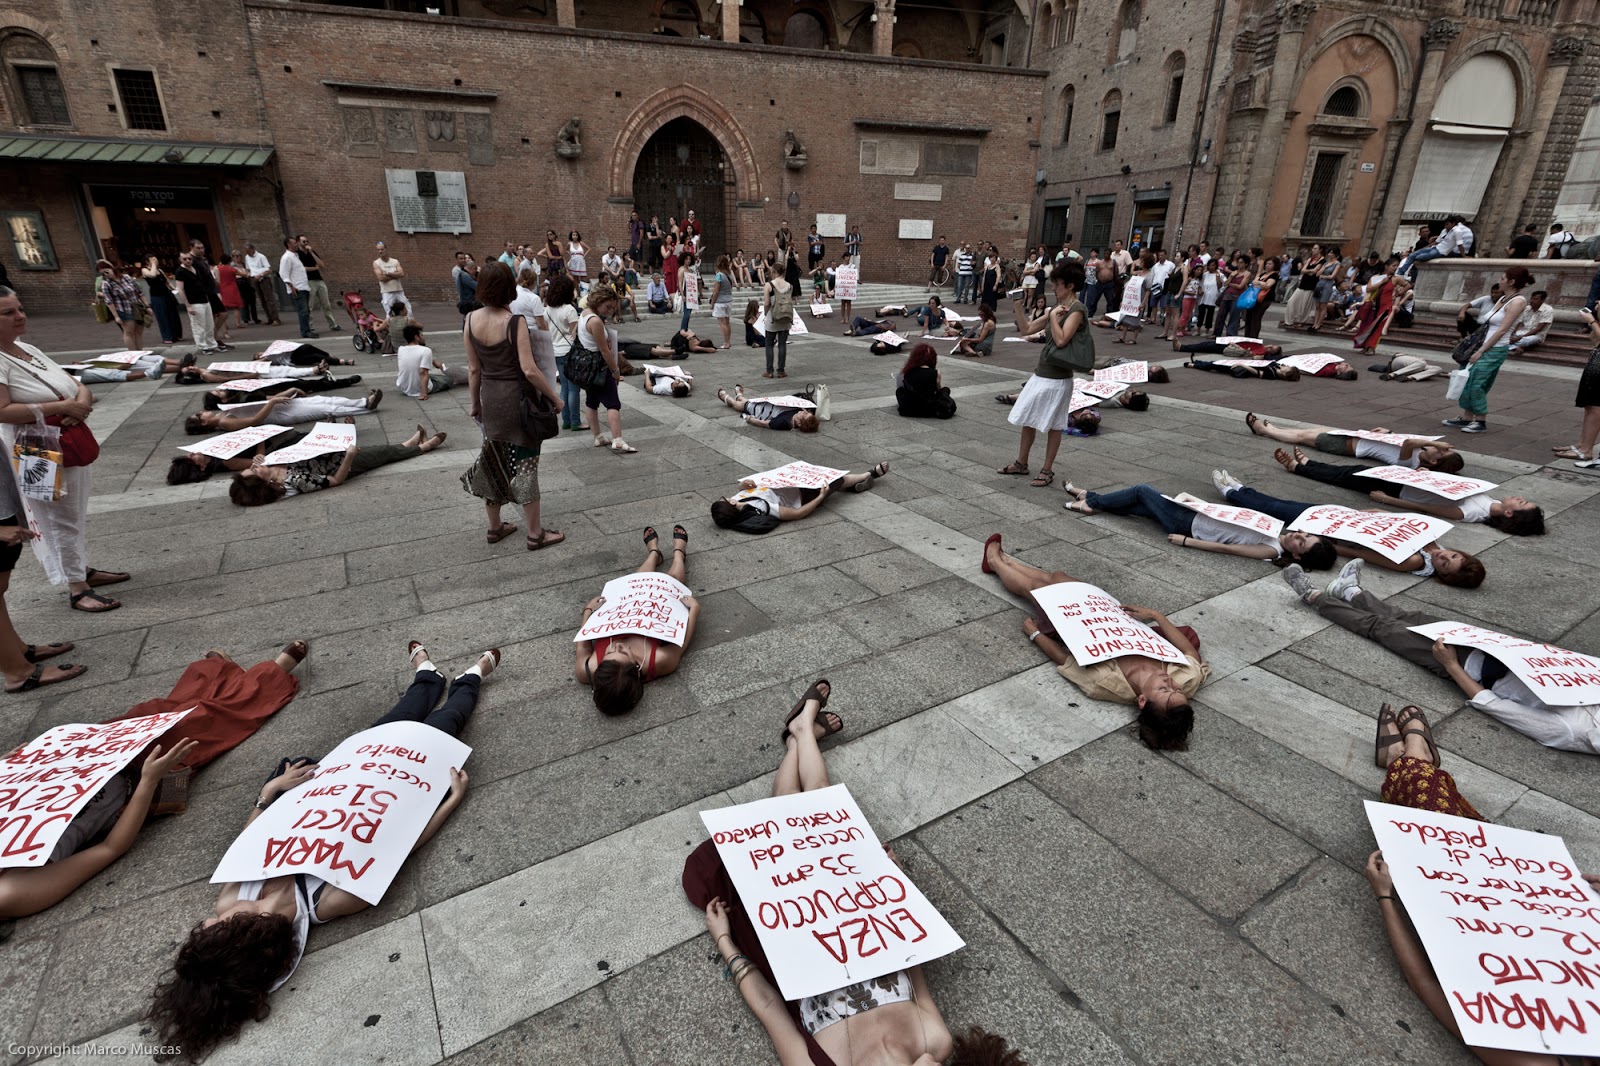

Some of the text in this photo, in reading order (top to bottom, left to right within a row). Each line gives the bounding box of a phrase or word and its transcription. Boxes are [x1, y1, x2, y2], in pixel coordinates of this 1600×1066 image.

[130, 190, 175, 200] FOR YOU
[1373, 519, 1428, 550] SILVANA
[582, 620, 677, 638] ESMERALDA
[608, 608, 669, 623] ROMERO
[1084, 640, 1178, 658] STEFANIA
[355, 744, 428, 764] marito
[314, 762, 432, 792] uccisa dal
[296, 784, 398, 815] 51 anni
[291, 809, 382, 844] RICCI
[786, 808, 850, 832] marito
[1389, 820, 1488, 848] pistola
[262, 836, 376, 880] MARIA
[748, 827, 864, 870] uccisa dal
[1441, 846, 1573, 881] 6 colpi di
[772, 854, 862, 887] 33 anni
[1416, 866, 1589, 902] partner con
[758, 876, 906, 930] CAPPUCCIO
[1440, 891, 1502, 912] dal
[812, 908, 928, 964] ENZA
[1446, 916, 1534, 938] anni
[1452, 990, 1588, 1034] MARIA
